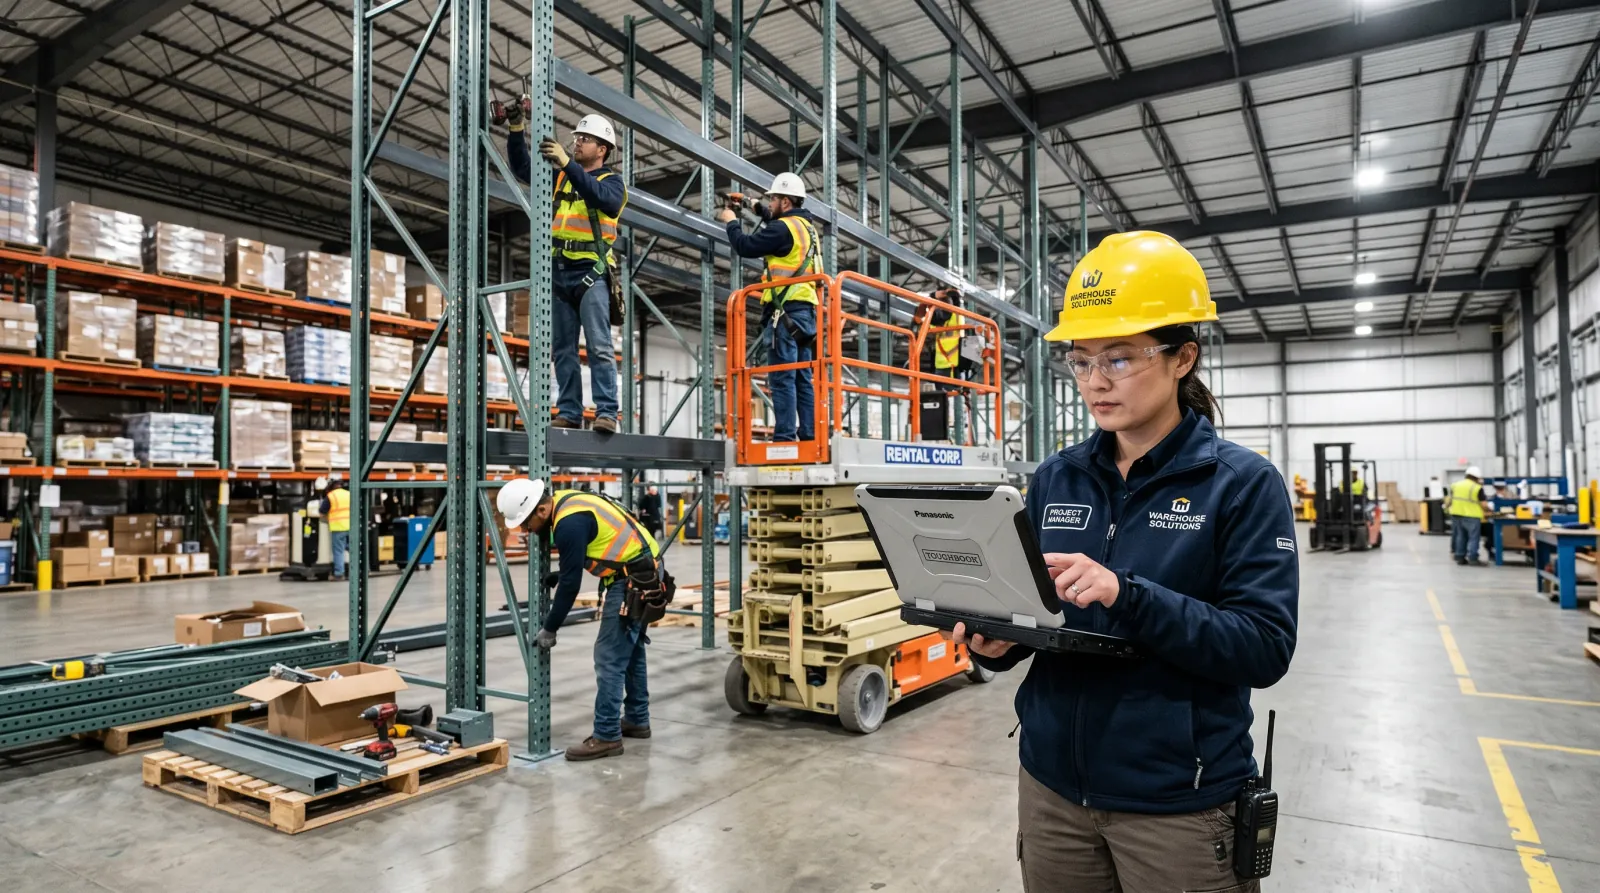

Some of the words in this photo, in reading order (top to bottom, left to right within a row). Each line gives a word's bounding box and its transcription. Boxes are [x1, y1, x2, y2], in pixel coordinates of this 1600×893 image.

[1071, 289, 1116, 301] WAREHOUSE
[1071, 298, 1112, 309] SOLUTIONS
[886, 446, 930, 463] RENTAL
[932, 449, 961, 465] CORP.
[914, 510, 954, 519] Panasonic
[1149, 511, 1206, 522] WAREHOUSE
[1149, 520, 1201, 530] SOLUTIONS
